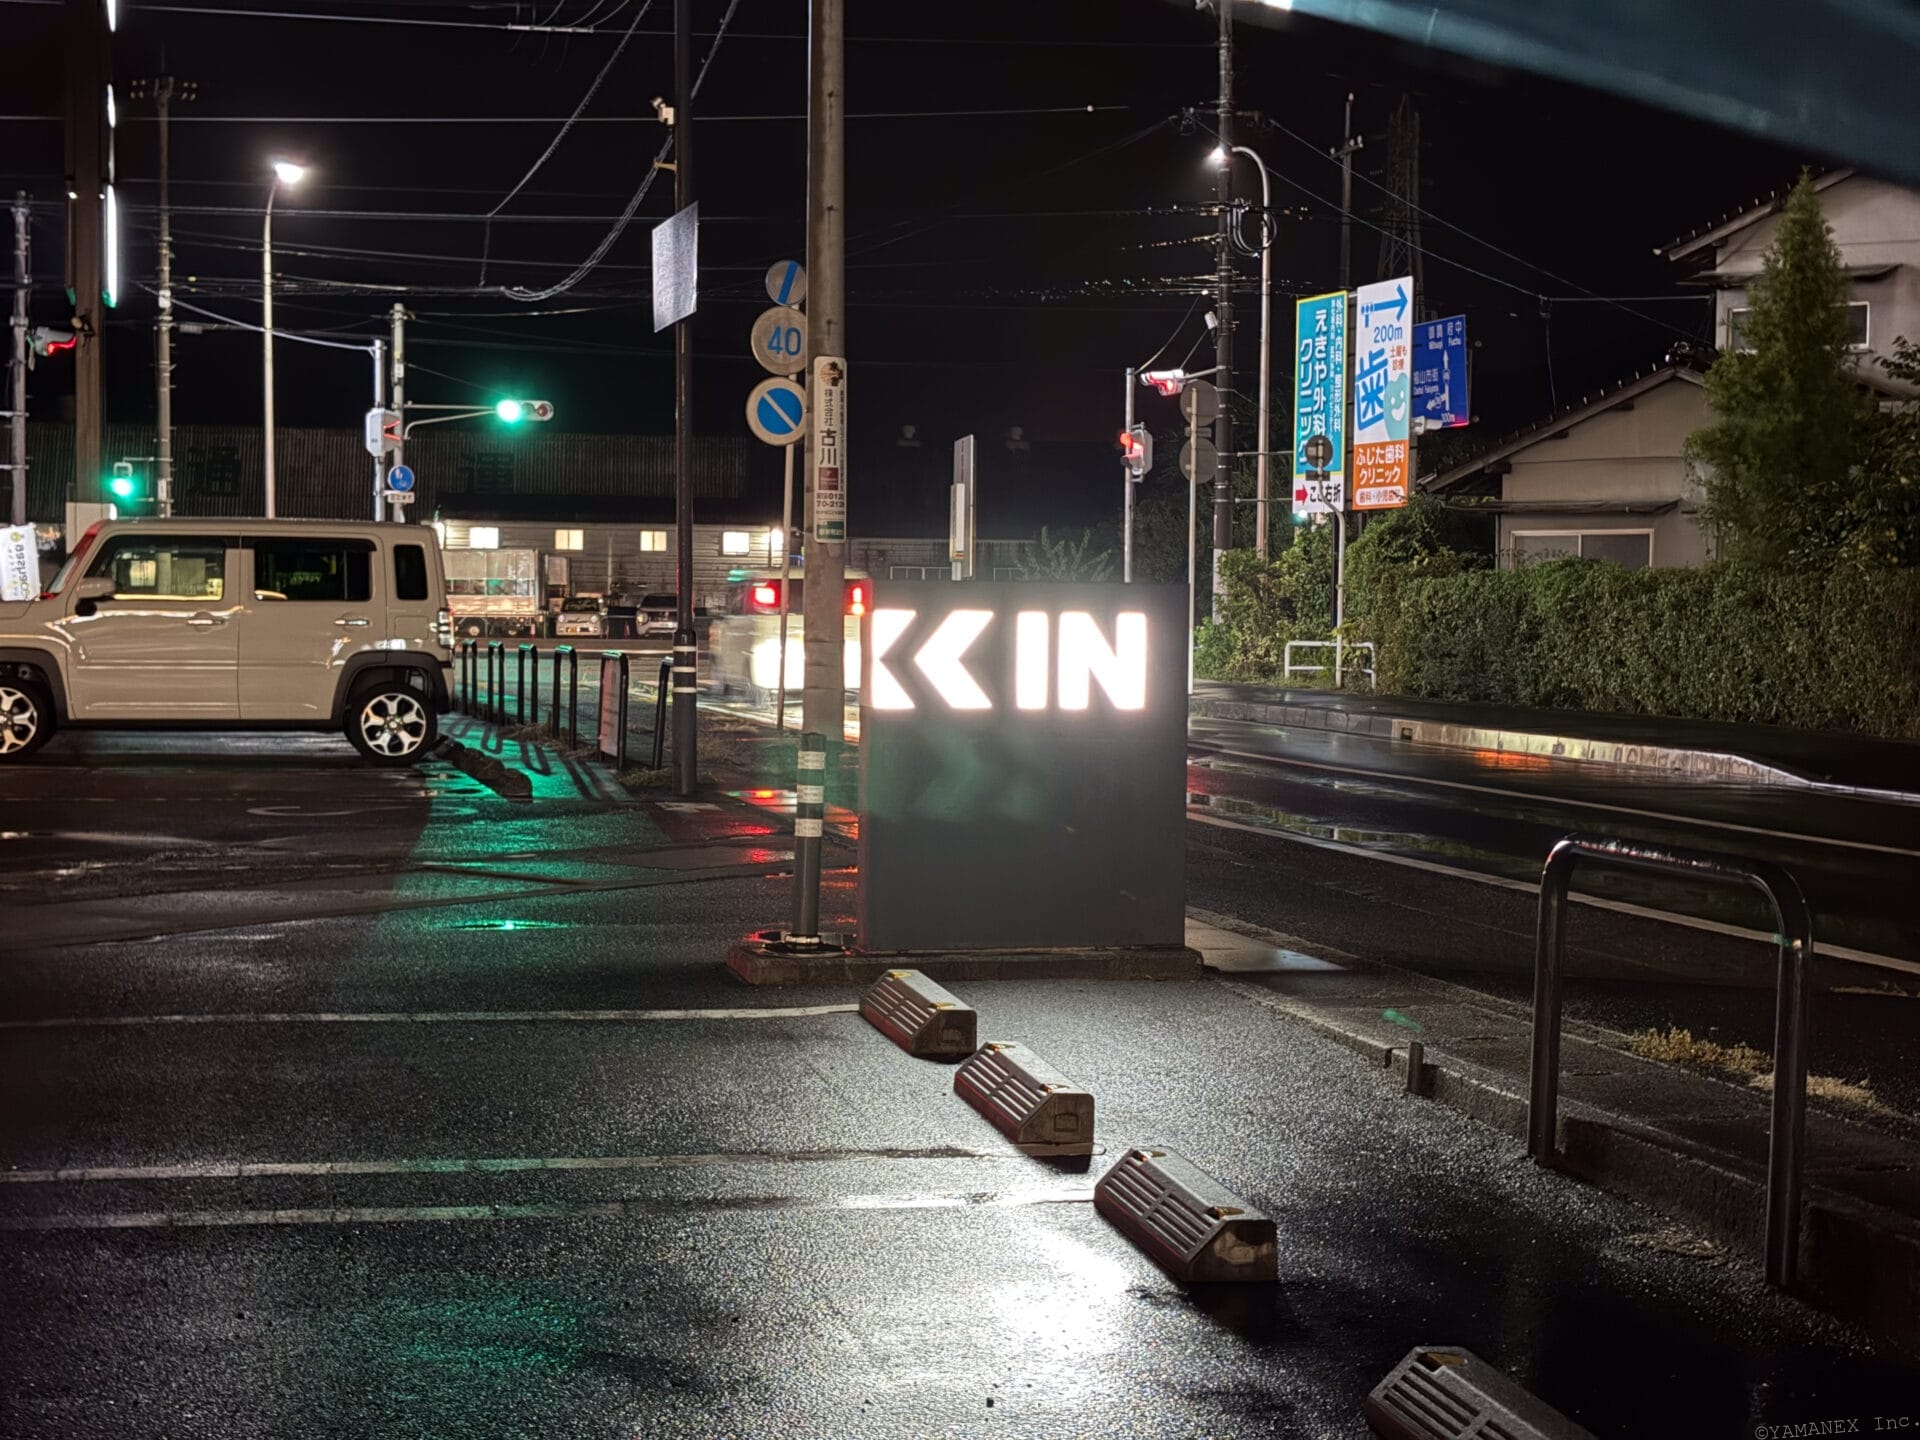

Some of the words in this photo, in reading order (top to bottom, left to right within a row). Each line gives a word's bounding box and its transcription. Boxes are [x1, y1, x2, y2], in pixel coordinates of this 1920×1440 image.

[767, 326, 802, 356] 40
[1374, 324, 1402, 343] 200m
[1313, 309, 1327, 436] えきや外科
[1355, 348, 1388, 430] 歯
[819, 428, 837, 466] 古川
[1356, 443, 1404, 465] ふじた歯科
[1360, 465, 1401, 485] クリニック
